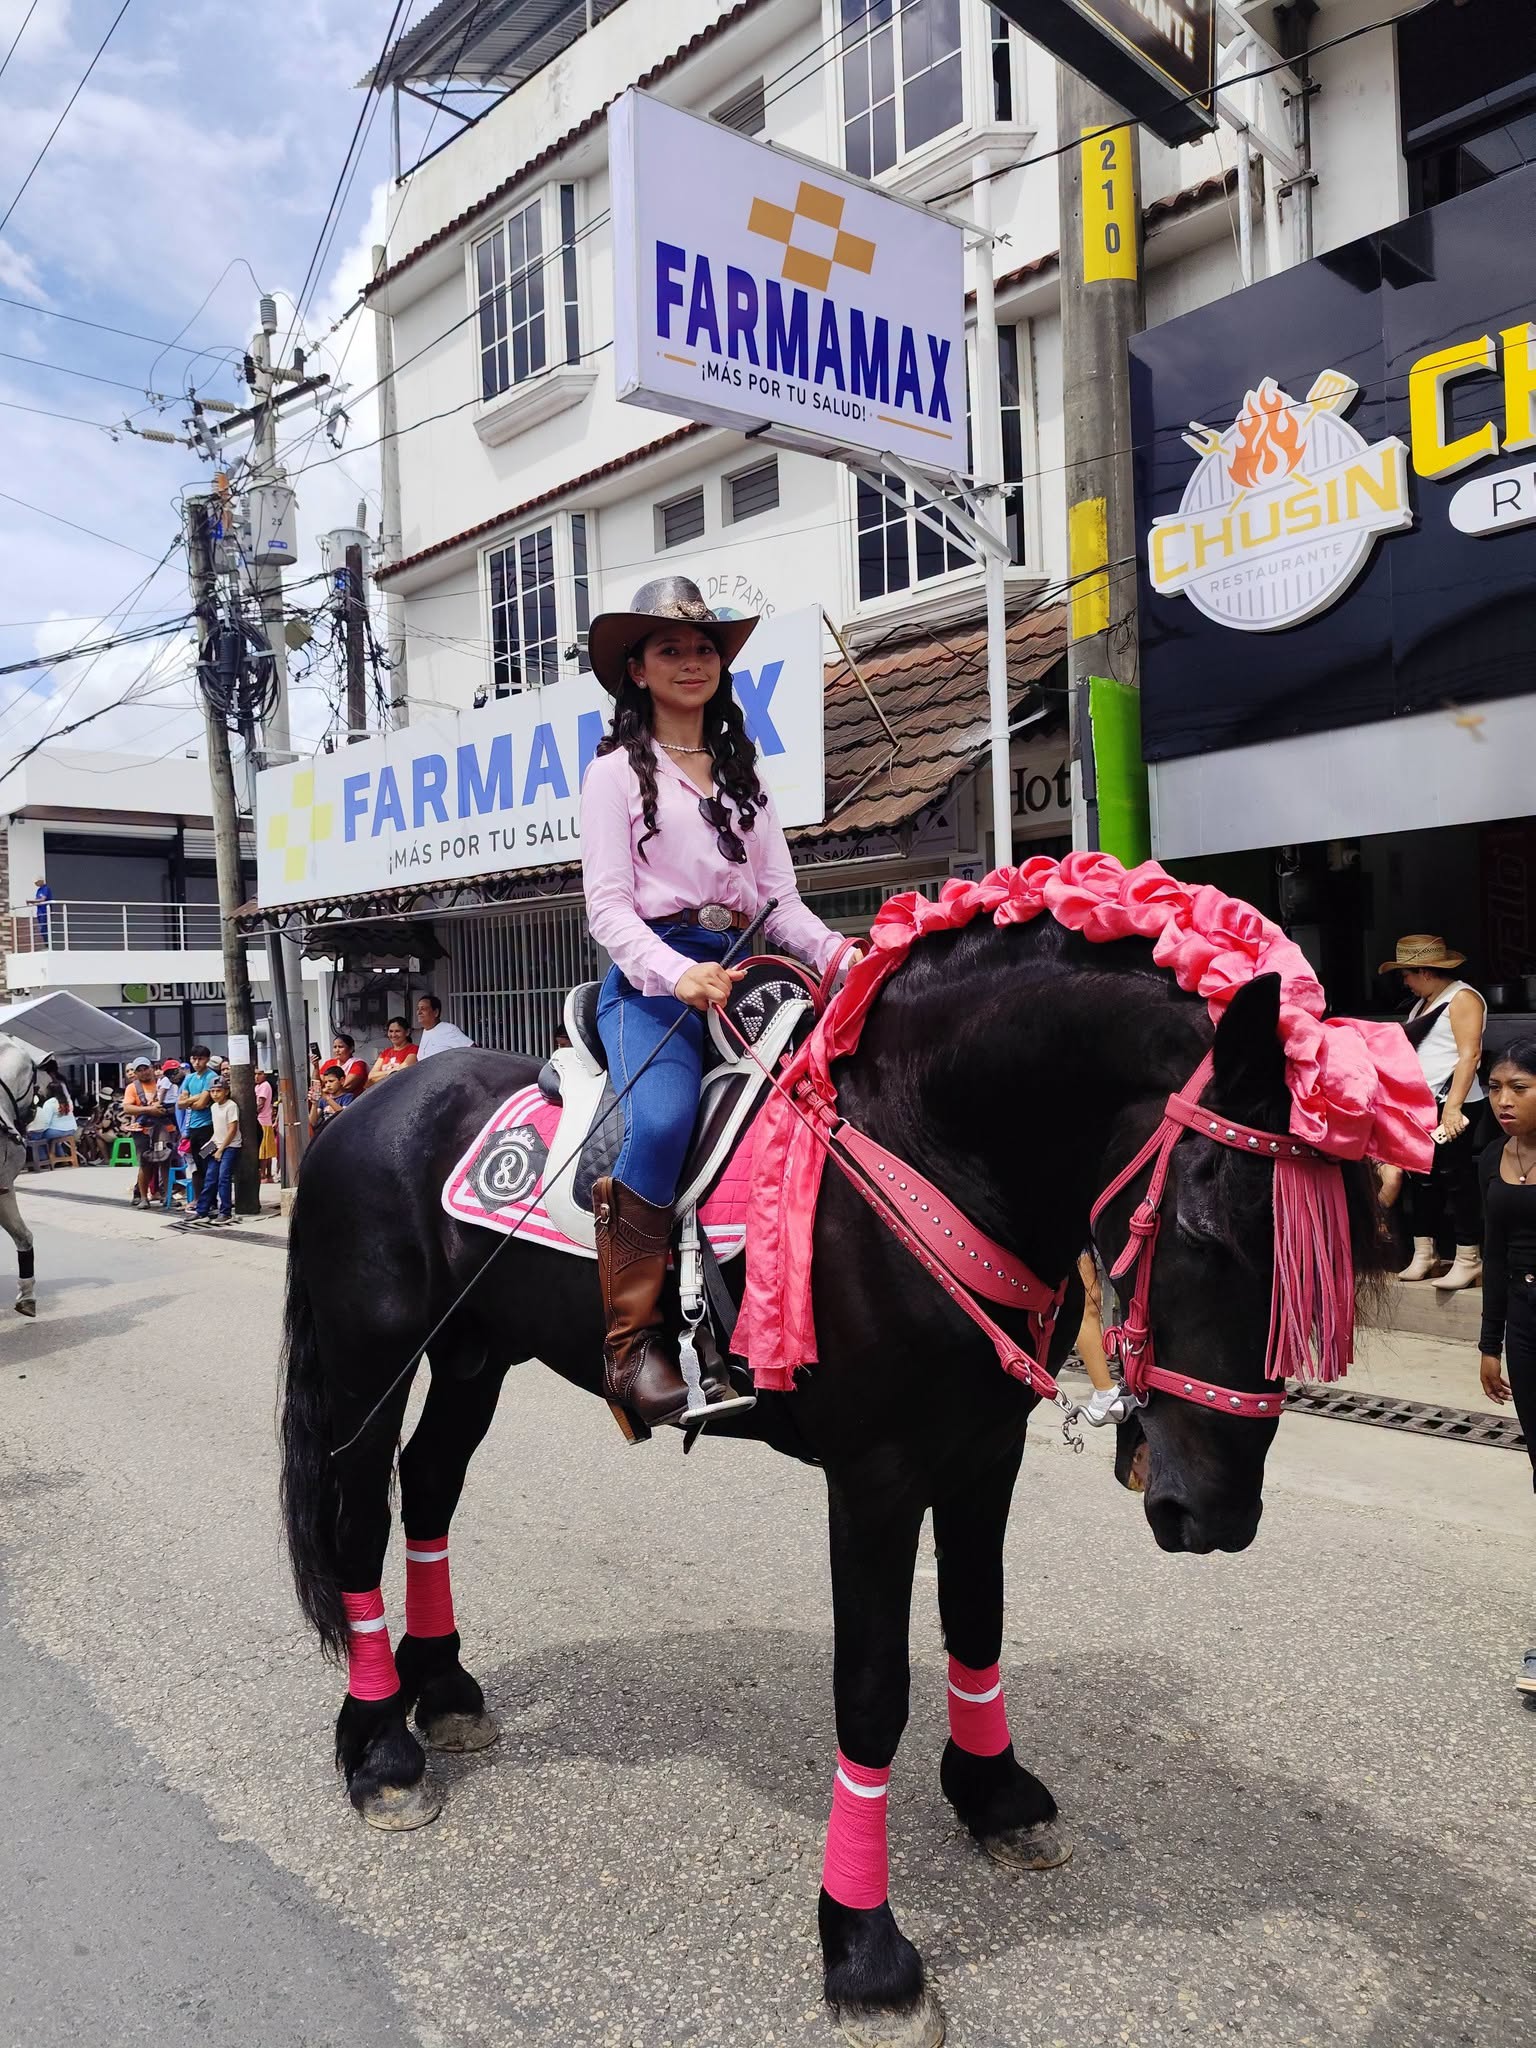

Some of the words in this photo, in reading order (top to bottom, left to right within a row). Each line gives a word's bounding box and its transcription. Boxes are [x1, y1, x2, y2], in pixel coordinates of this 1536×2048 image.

[1128, 0, 1194, 60] ANTE
[1100, 139, 1121, 254] 210
[656, 240, 952, 423] FARMAMAX
[702, 360, 742, 386] ¡MÁS
[749, 374, 780, 398] POR
[787, 384, 806, 405] TU
[813, 392, 866, 421] SALUD!
[707, 575, 728, 599] DE
[1210, 542, 1344, 593] RESTAURANTE
[343, 660, 786, 843] FARMAX
[389, 840, 432, 875] ¡MÁS
[440, 834, 480, 862] POR
[489, 827, 516, 852] TU
[147, 981, 255, 1001] DELIMUN
